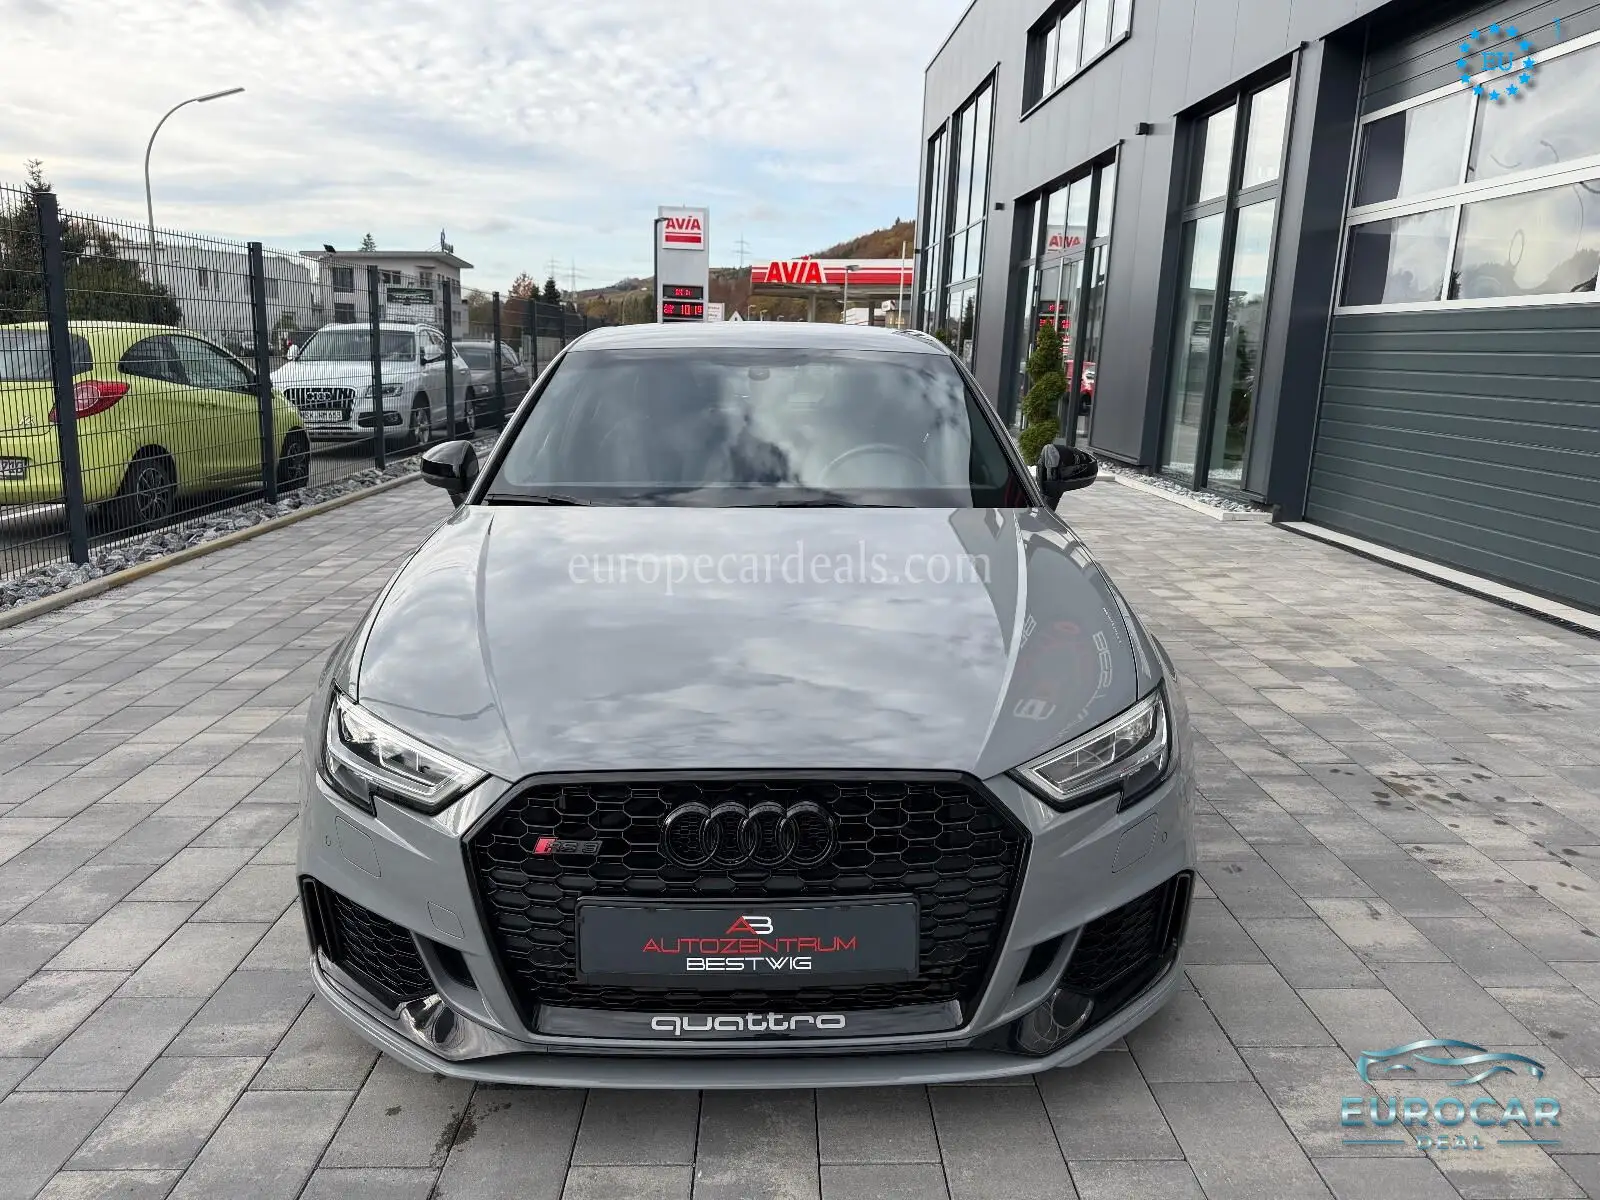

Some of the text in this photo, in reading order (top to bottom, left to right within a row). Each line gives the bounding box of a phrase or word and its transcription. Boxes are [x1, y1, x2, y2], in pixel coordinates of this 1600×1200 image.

[766, 257, 823, 283] AVIA
[725, 915, 774, 935] AB
[642, 937, 858, 954] AUTOZENTRUM
[686, 956, 812, 971] BESTWIG
[651, 1012, 846, 1036] quattro
